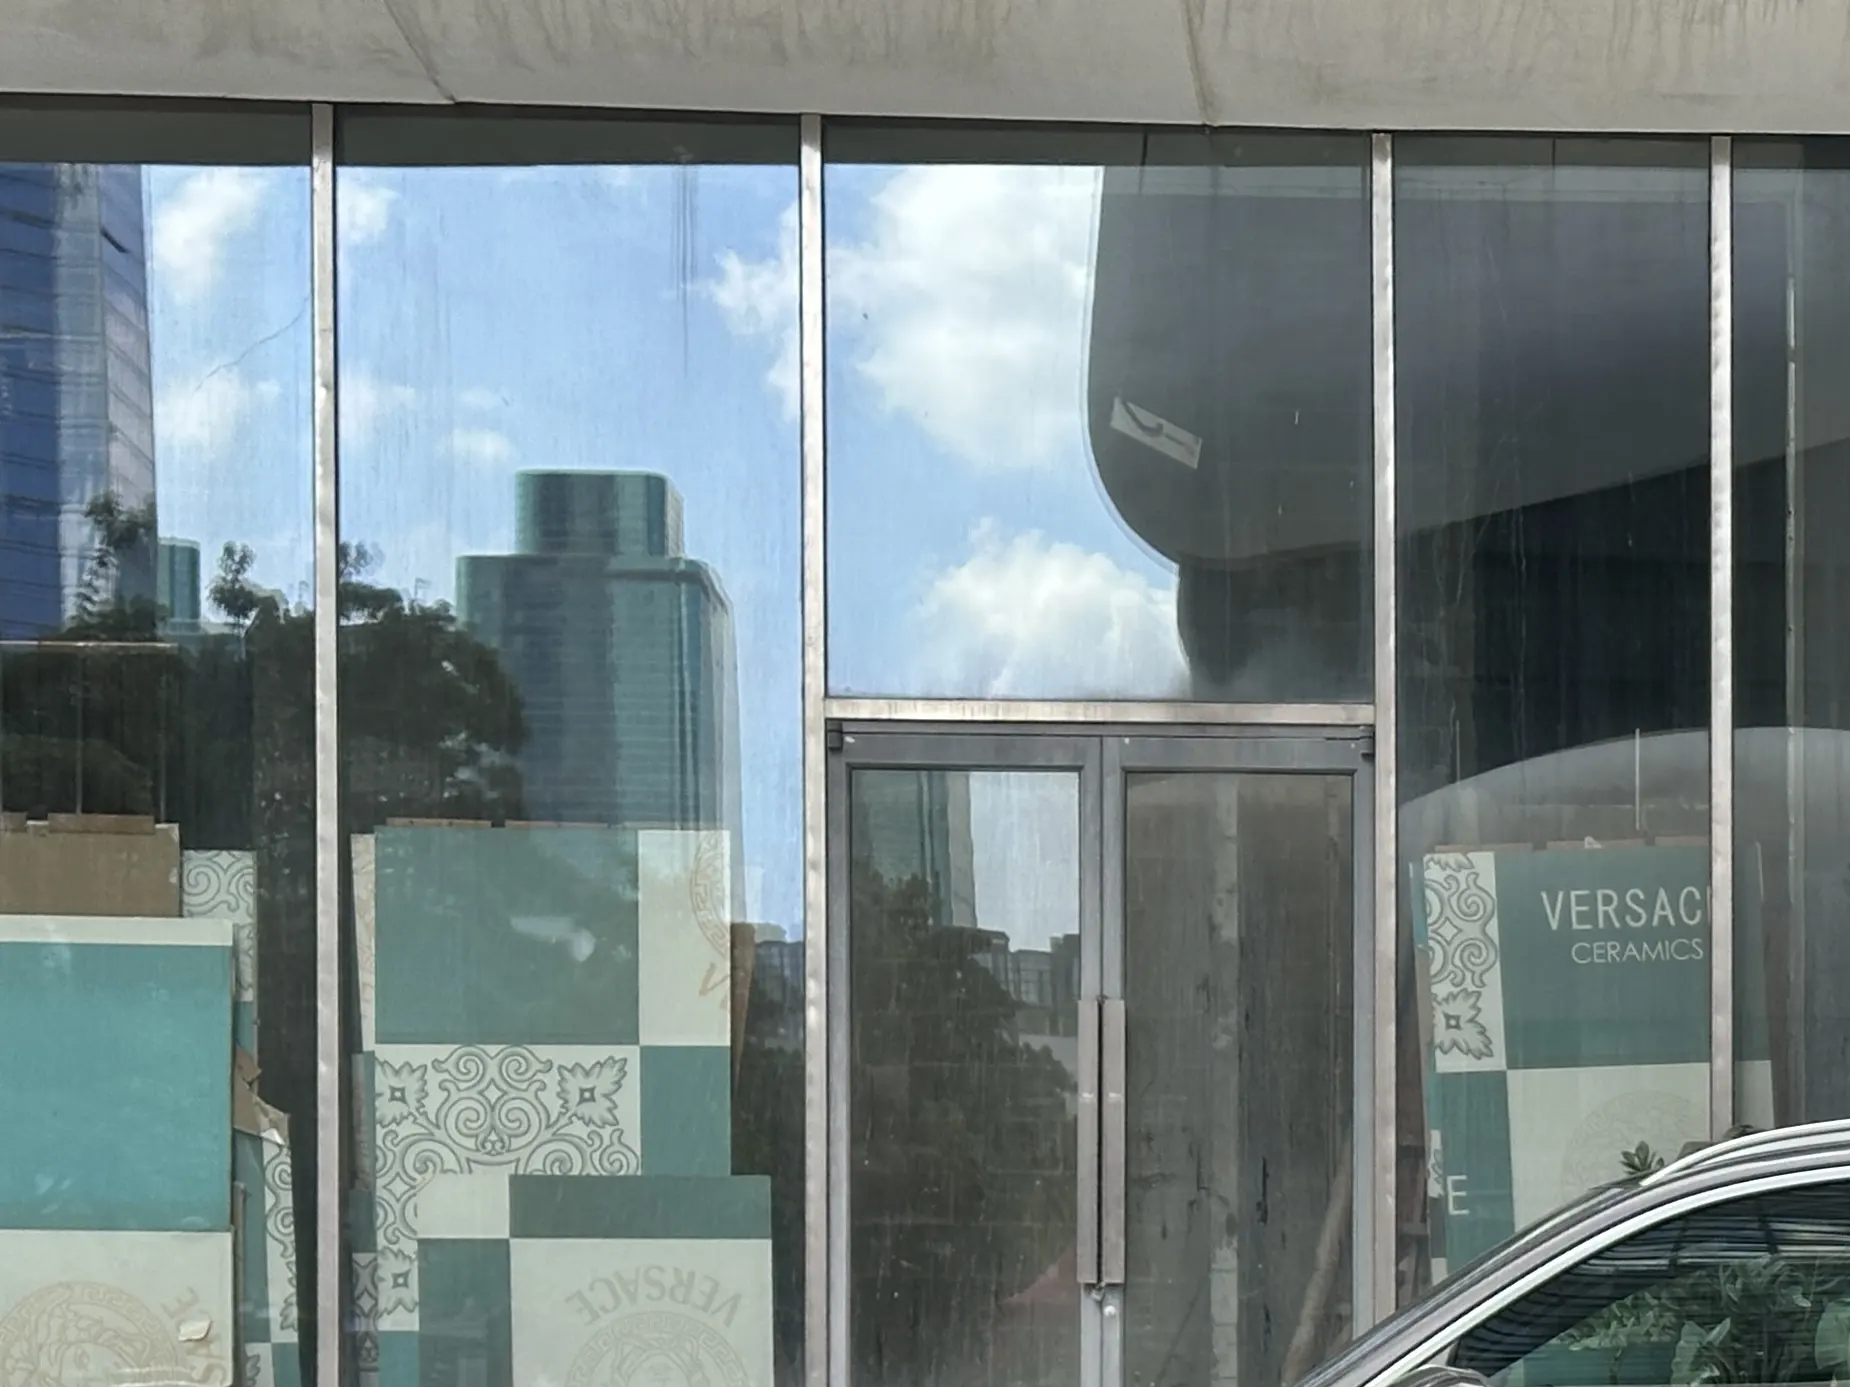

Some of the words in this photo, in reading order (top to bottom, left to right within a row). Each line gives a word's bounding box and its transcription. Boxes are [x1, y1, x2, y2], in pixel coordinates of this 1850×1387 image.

[1541, 886, 1711, 930] VERSAC
[1571, 938, 1704, 964] CERAMICS
[564, 1265, 743, 1328] VERSACE
